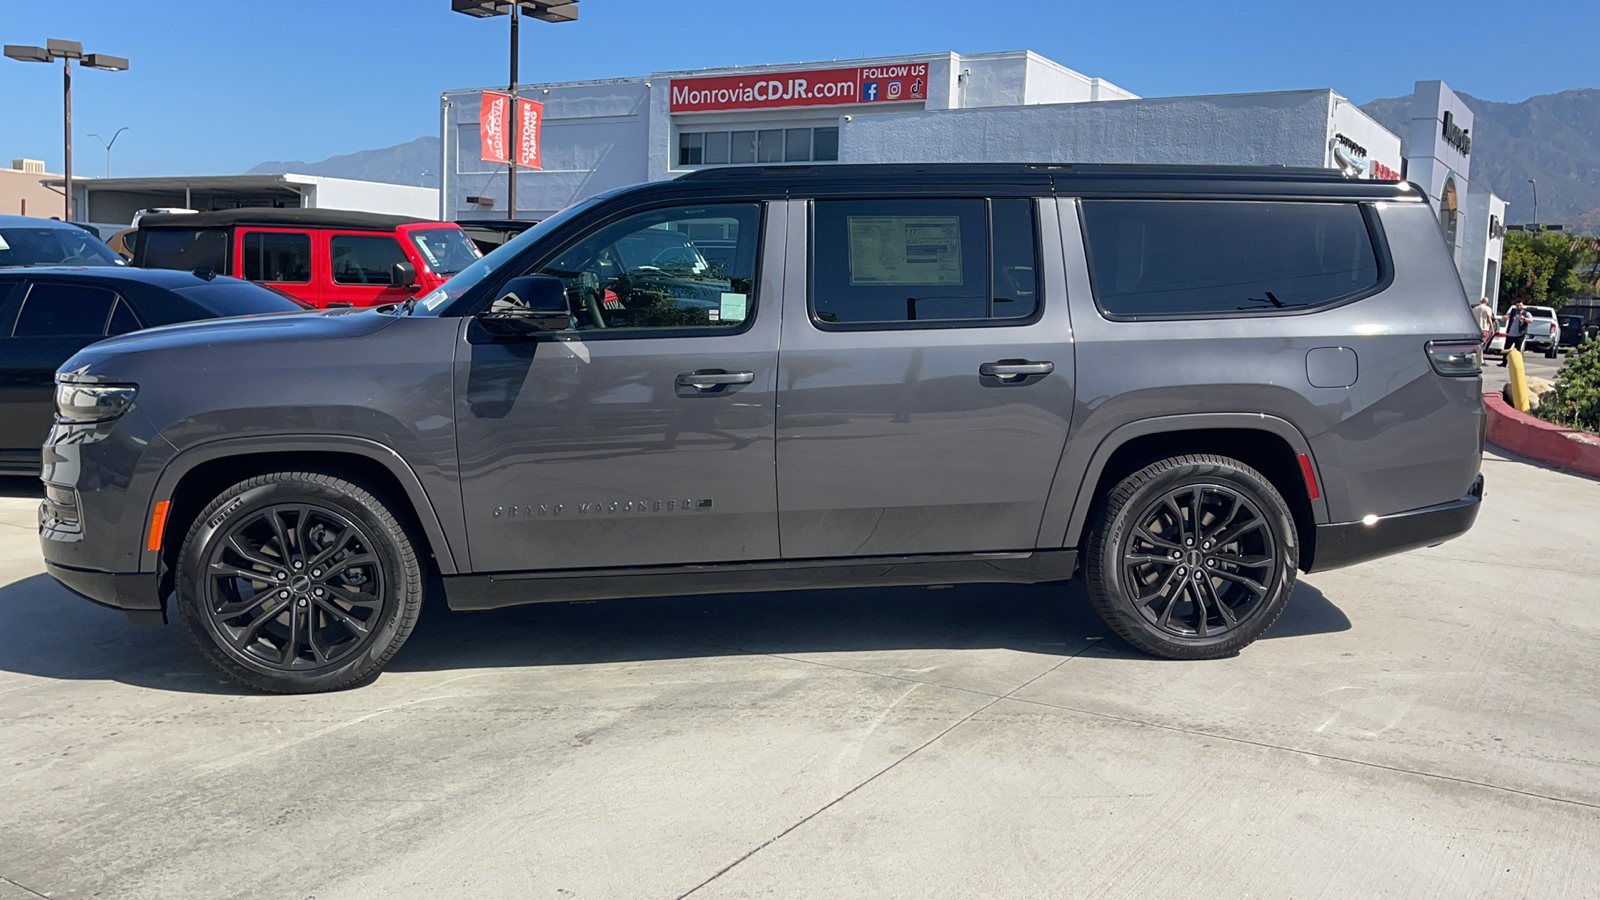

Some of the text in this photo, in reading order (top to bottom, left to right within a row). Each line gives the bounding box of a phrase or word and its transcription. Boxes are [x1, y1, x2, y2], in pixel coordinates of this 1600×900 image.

[863, 65, 925, 79] FOLLOW US
[673, 79, 854, 105] MonroviaCDJR.com
[494, 99, 502, 157] MONROVIA
[522, 103, 531, 164] CUSTOMER
[529, 111, 537, 159] PARKING
[206, 497, 243, 529] PIRELLI
[493, 499, 691, 517] GRAND WAGONEER
